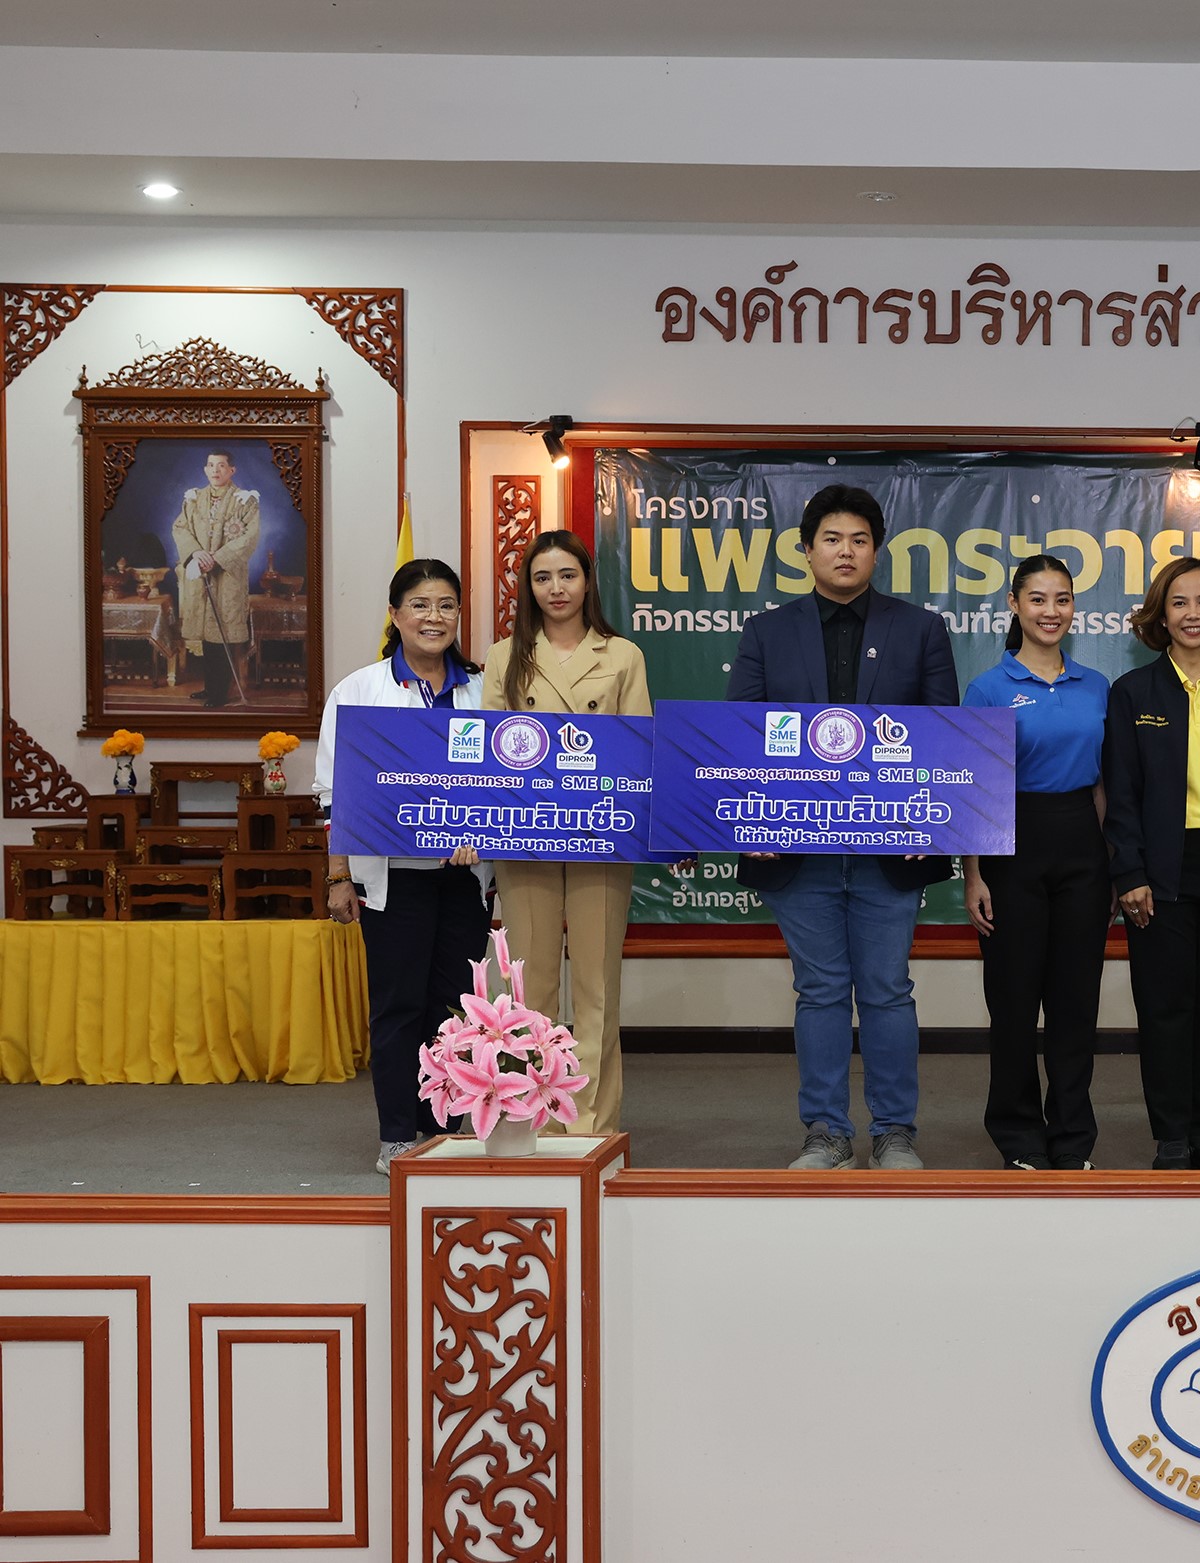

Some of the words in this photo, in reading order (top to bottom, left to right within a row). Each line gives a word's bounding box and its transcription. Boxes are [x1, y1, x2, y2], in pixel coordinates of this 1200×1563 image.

[632, 488, 768, 520] โครงการ
[630, 527, 816, 595] แพร
[453, 737, 480, 746] SME
[770, 730, 797, 740] SME
[452, 750, 480, 759] Bank
[769, 744, 796, 753] Bank
[377, 772, 523, 789] กระทรวงอุตสาหกรรม
[532, 778, 553, 789] และ
[561, 775, 598, 791] SME
[600, 777, 614, 791] D
[695, 766, 840, 785] กระทรวงอุตสาหกรรม
[849, 771, 869, 782] และ
[877, 768, 913, 783] SME
[916, 768, 929, 783] D
[932, 769, 973, 784] Bank
[397, 797, 635, 836] สนับสนุนสินเชื่อ
[715, 789, 952, 829] สนับสนุนสินเชื่อ
[569, 839, 614, 854] SMEs
[735, 827, 883, 848] ให้กับผู้ประกอบการ
[885, 832, 931, 846] SMEs
